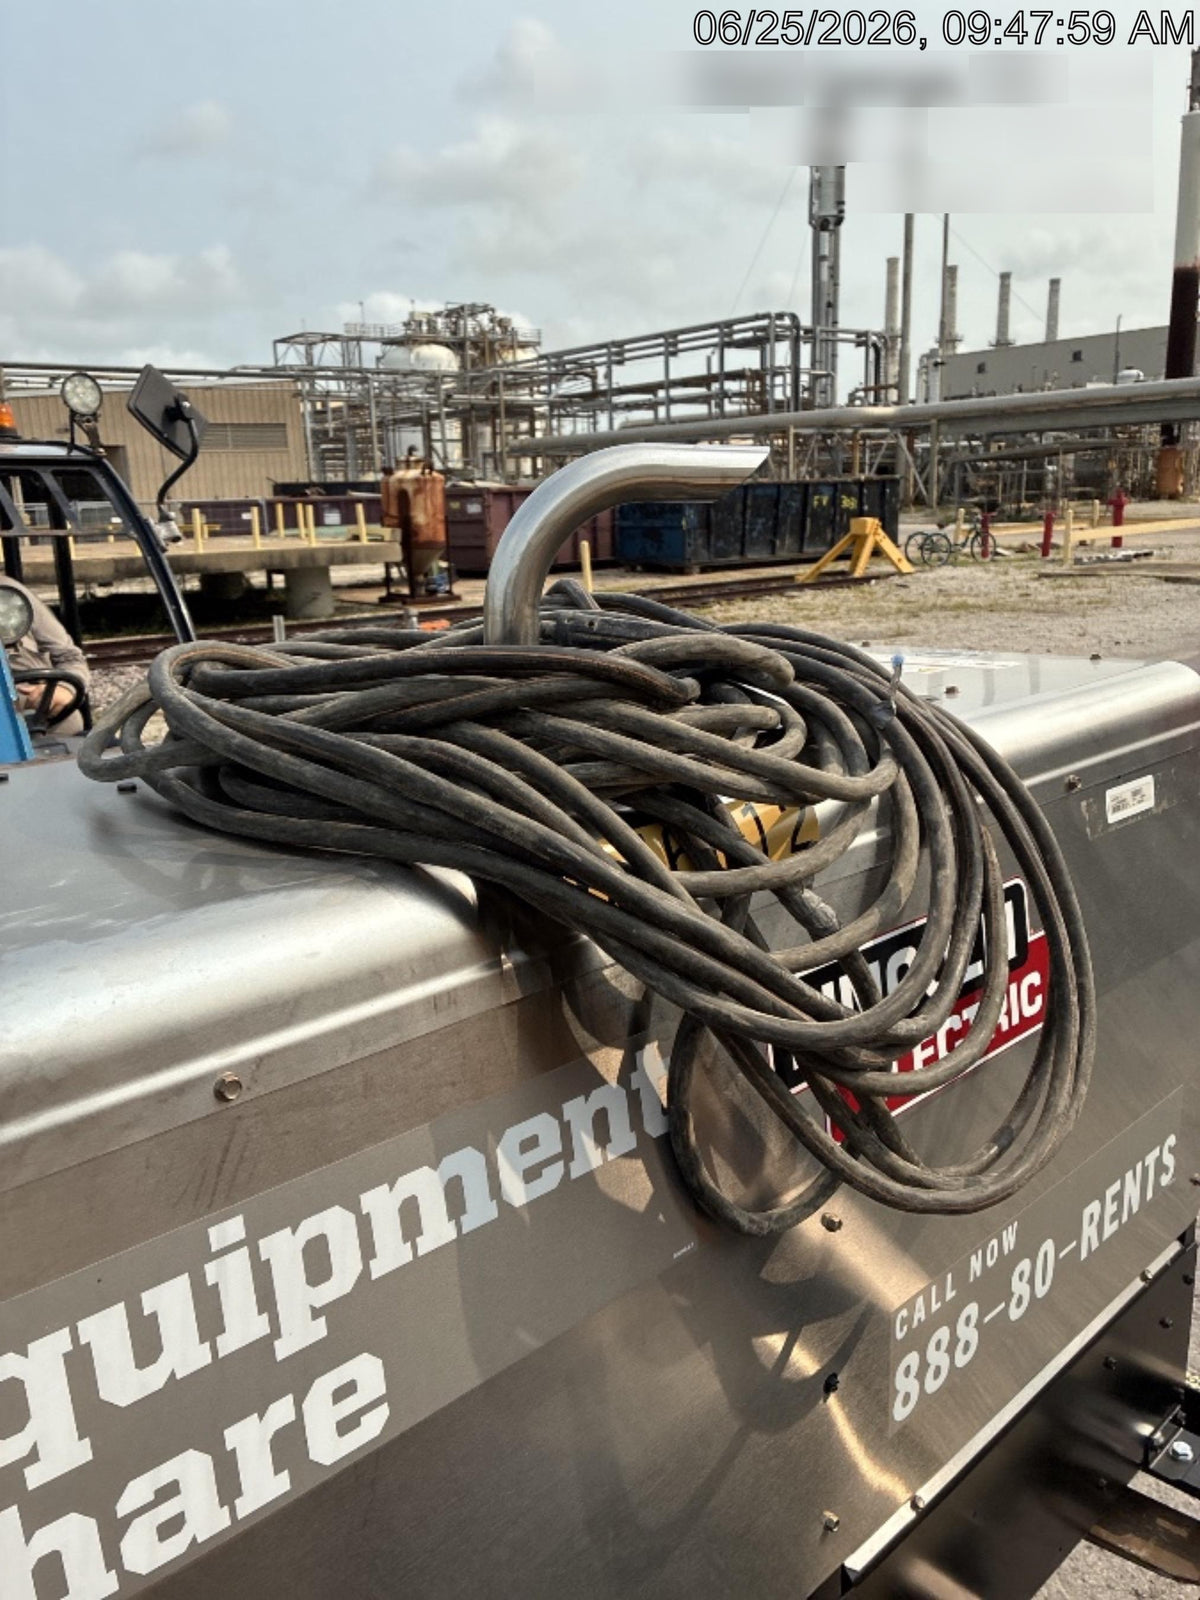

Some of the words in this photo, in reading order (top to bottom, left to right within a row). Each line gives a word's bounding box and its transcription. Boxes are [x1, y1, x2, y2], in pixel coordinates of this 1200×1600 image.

[893, 1133, 1176, 1422] 888-80-RENTS
[895, 1272, 956, 1341] CALL
[969, 1221, 1018, 1282] NOW
[0, 1352, 390, 1600] hare
